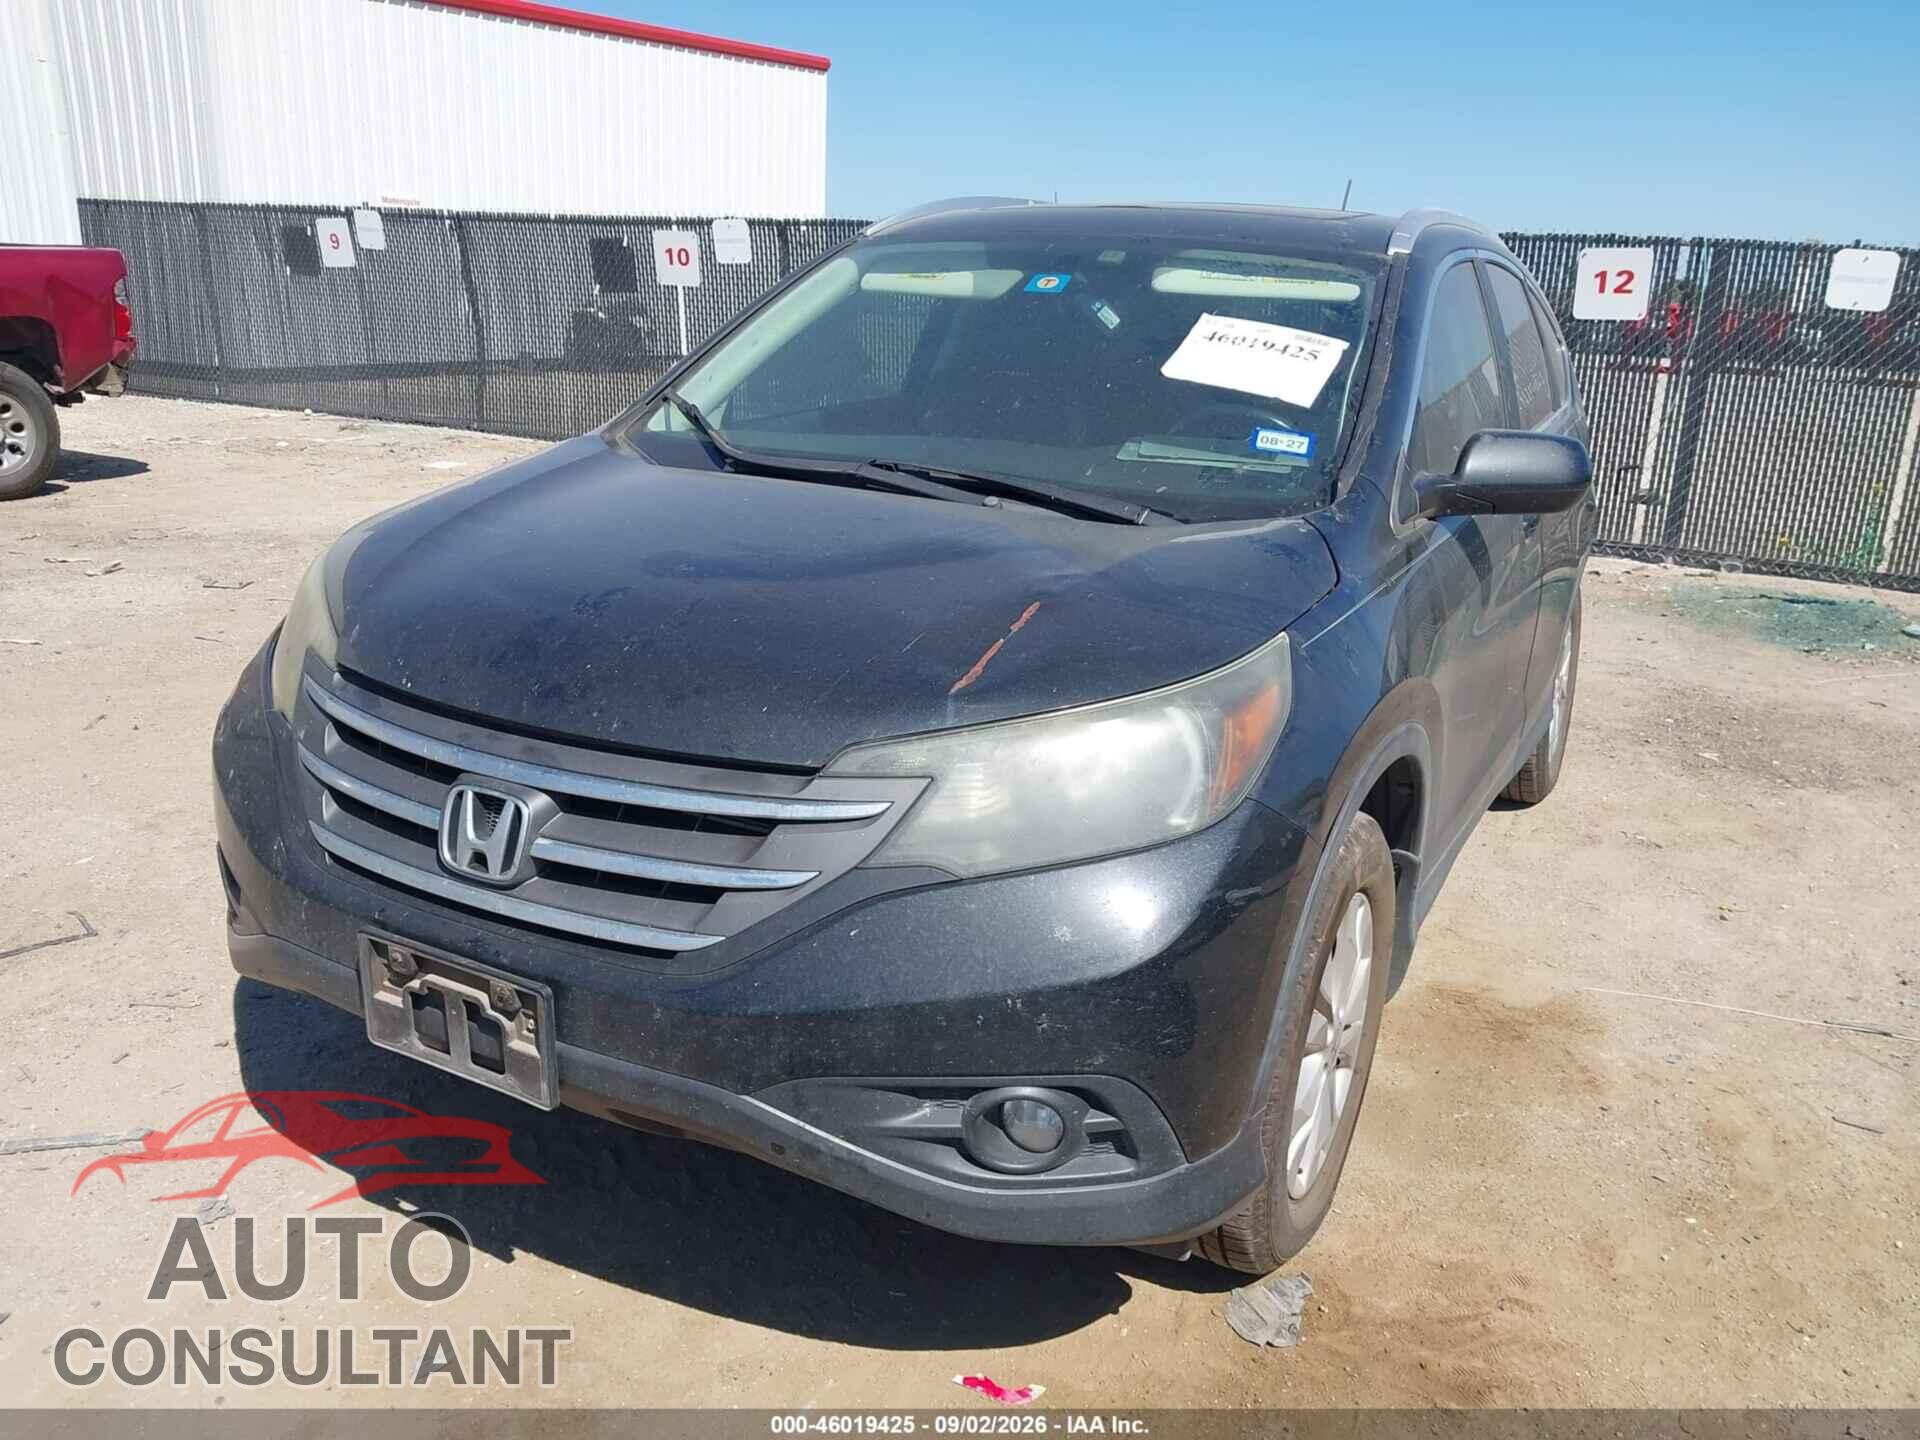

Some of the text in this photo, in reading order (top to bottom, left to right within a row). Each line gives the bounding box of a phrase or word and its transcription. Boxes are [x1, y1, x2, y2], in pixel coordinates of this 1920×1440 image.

[329, 233, 340, 250] 9
[664, 247, 691, 267] 10
[1593, 269, 1635, 294] 12
[1202, 330, 1321, 362] 46019425
